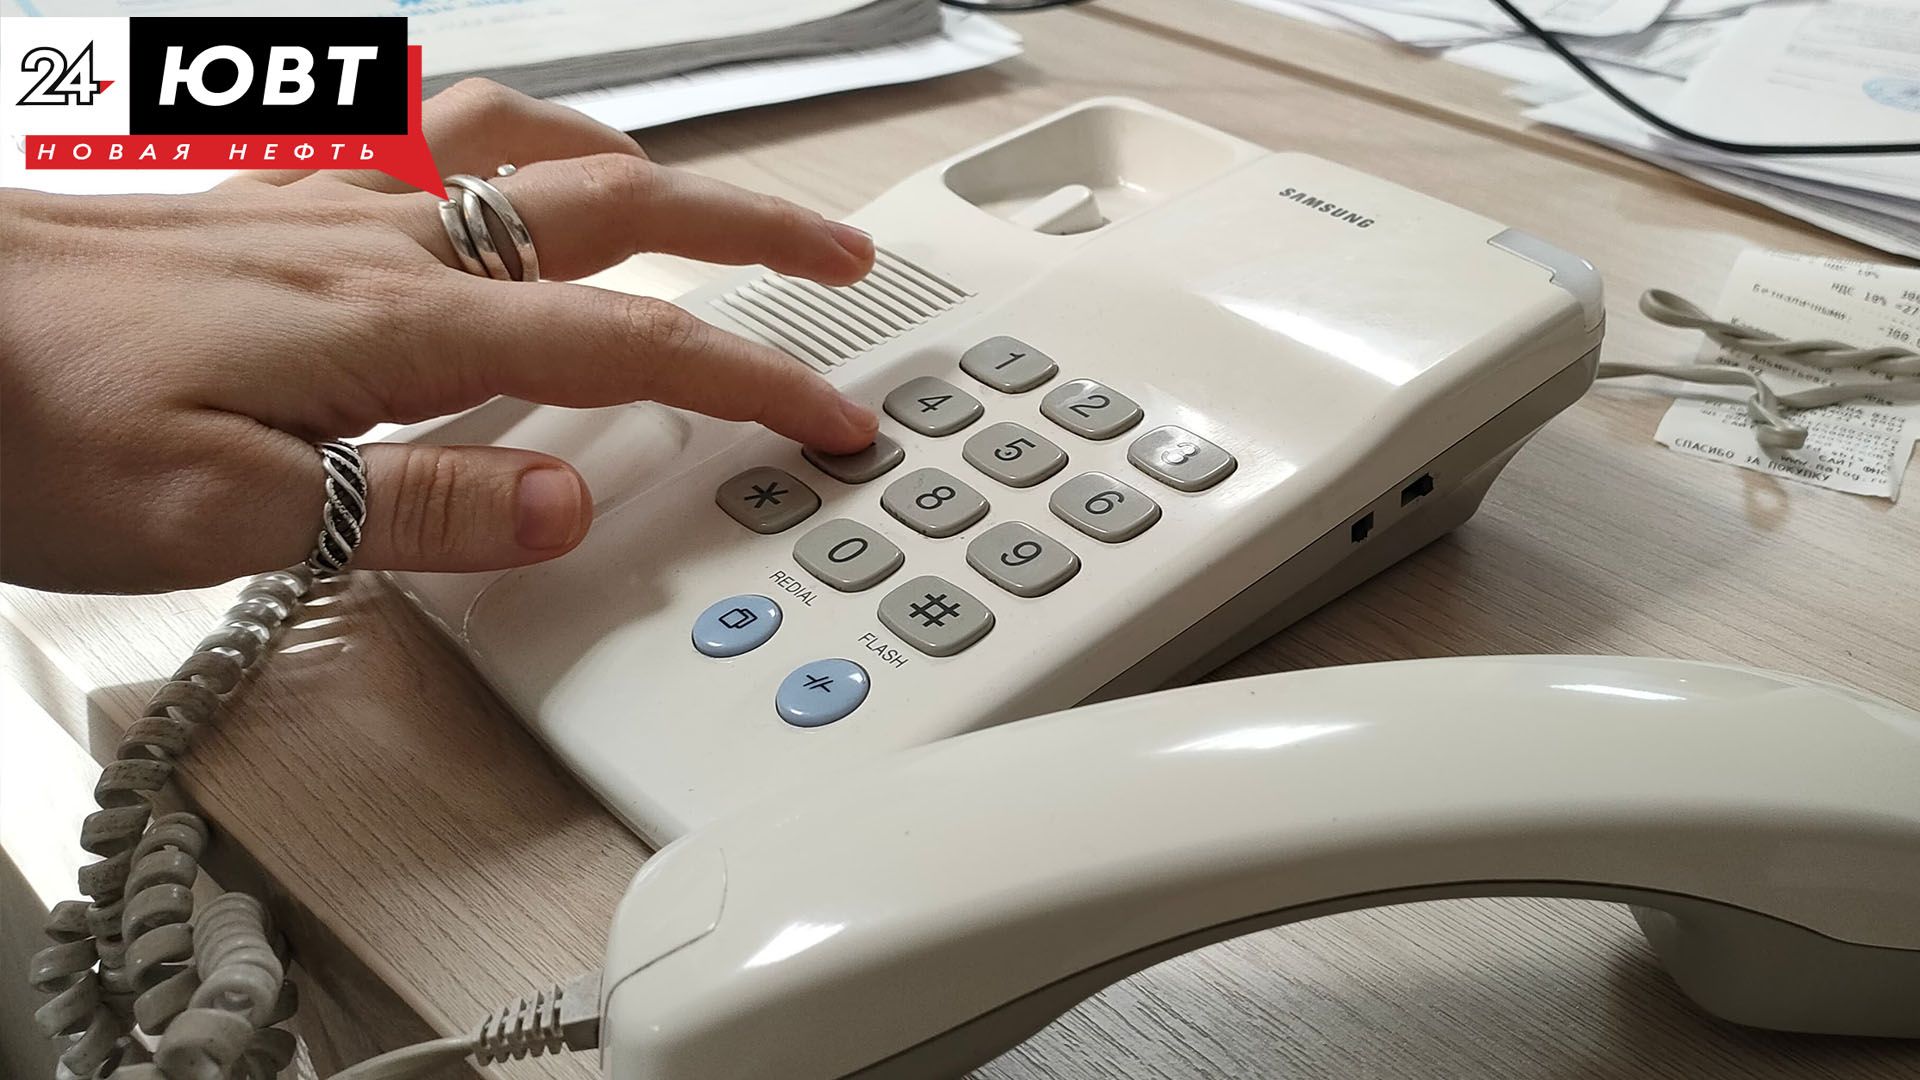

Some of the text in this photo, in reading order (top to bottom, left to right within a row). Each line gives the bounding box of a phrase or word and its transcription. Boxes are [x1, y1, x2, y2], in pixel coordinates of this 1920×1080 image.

[1279, 188, 1375, 228] SAMSUNG
[994, 352, 1026, 370] 1
[917, 395, 953, 413] 4
[1068, 394, 1111, 418] 2
[994, 437, 1037, 462] 5
[1161, 442, 1201, 466] 3
[1674, 437, 1831, 482] СПАСИБО ЗА ПОКУПКУ
[915, 485, 956, 510] 8
[1084, 490, 1125, 515] 6
[827, 537, 869, 563] 0
[1000, 541, 1043, 567] 9
[769, 570, 818, 607] REDIAL
[857, 632, 909, 669] FLASH
